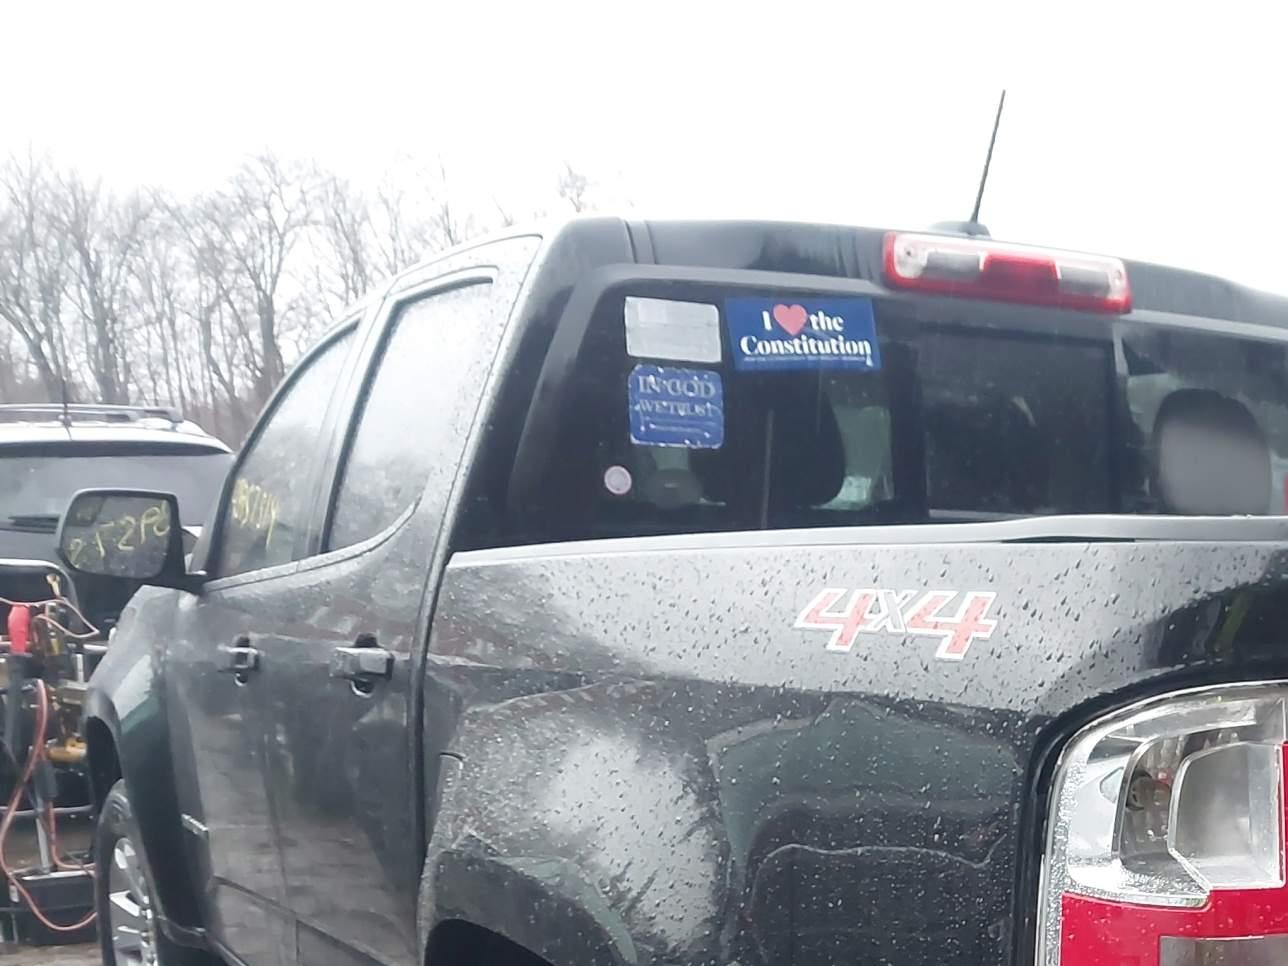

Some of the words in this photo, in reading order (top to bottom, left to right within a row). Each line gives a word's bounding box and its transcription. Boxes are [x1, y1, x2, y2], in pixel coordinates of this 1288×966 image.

[761, 310, 773, 331] I
[809, 310, 844, 332] the
[739, 334, 873, 367] Constitution
[638, 374, 661, 394] IN
[667, 378, 716, 399] GOD
[639, 399, 665, 413] WE
